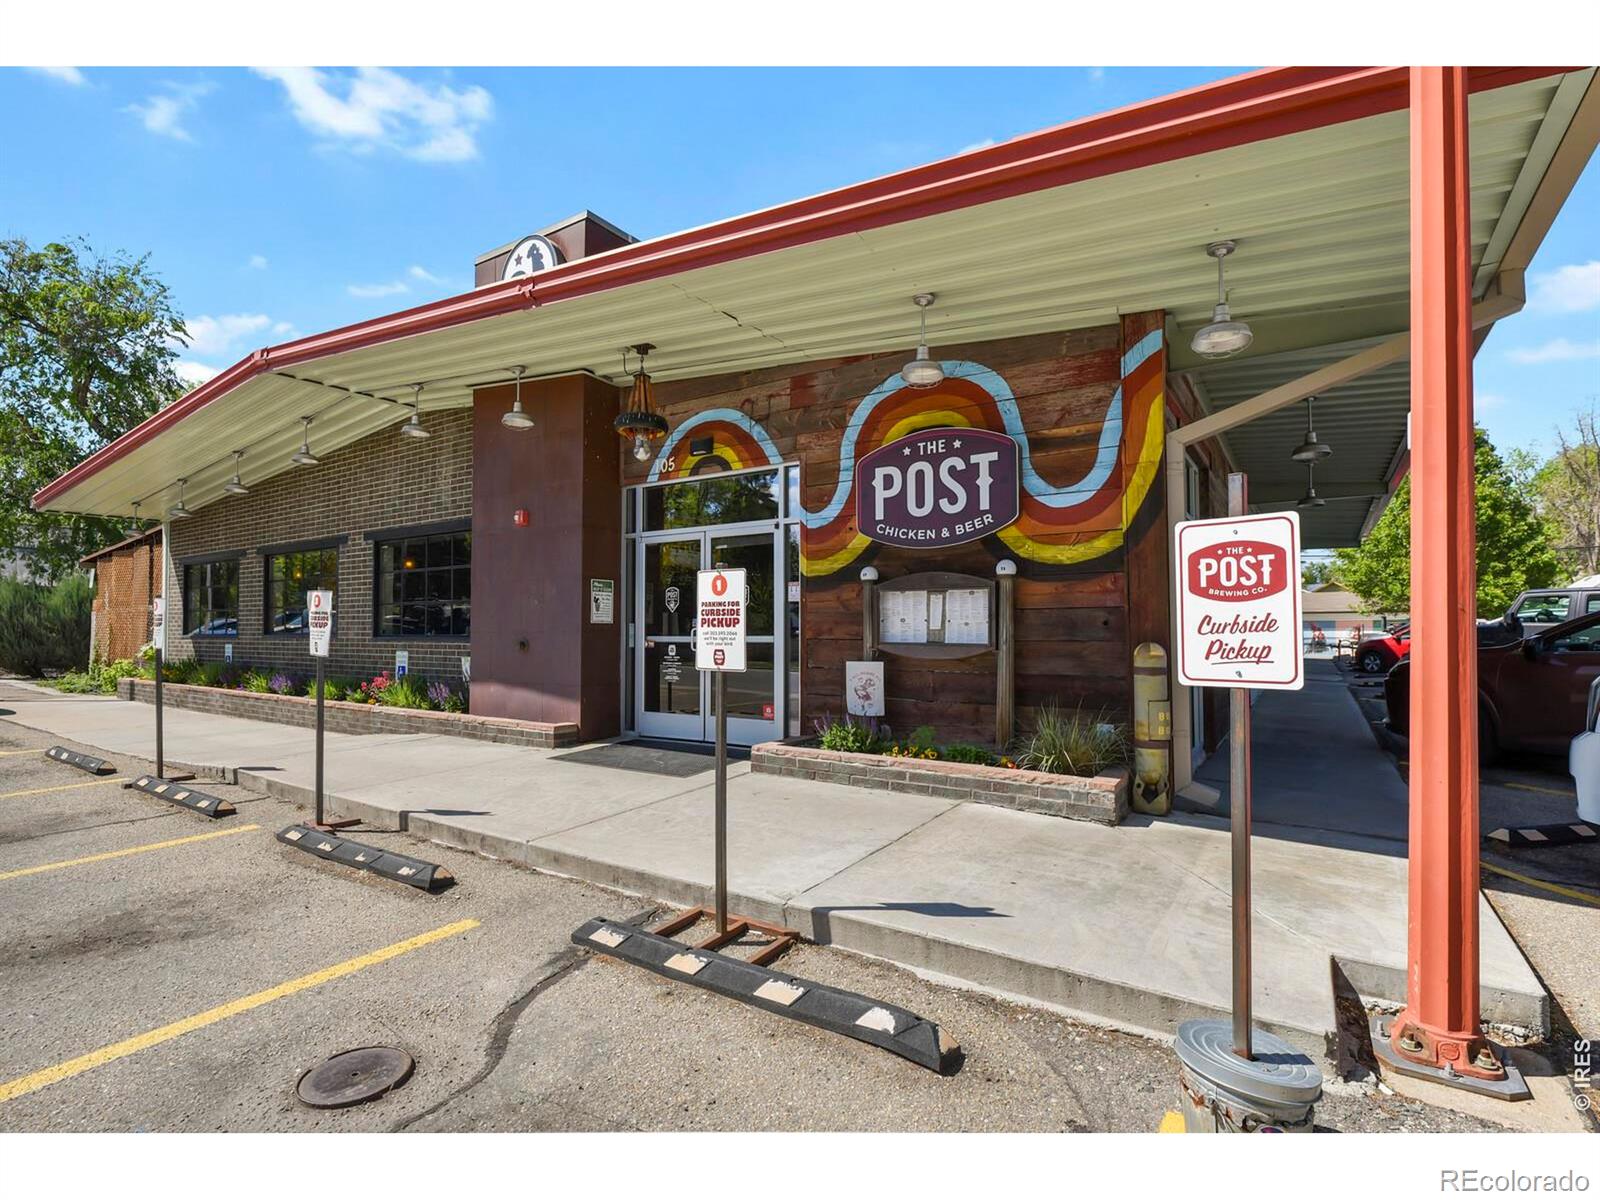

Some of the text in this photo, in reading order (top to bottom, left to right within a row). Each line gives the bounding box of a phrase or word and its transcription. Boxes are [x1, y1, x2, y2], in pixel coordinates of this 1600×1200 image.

[918, 439, 946, 455] THE
[872, 452, 998, 520] POST
[876, 514, 994, 540] CHICKEN & BEER
[1226, 546, 1244, 554] THE
[1198, 554, 1275, 588] POST
[1208, 586, 1268, 597] BREWING CO.
[700, 608, 741, 617] CURBSIDE
[700, 617, 740, 628] PICKUP
[1197, 613, 1279, 635] Curbside
[1205, 638, 1272, 665] Pickup
